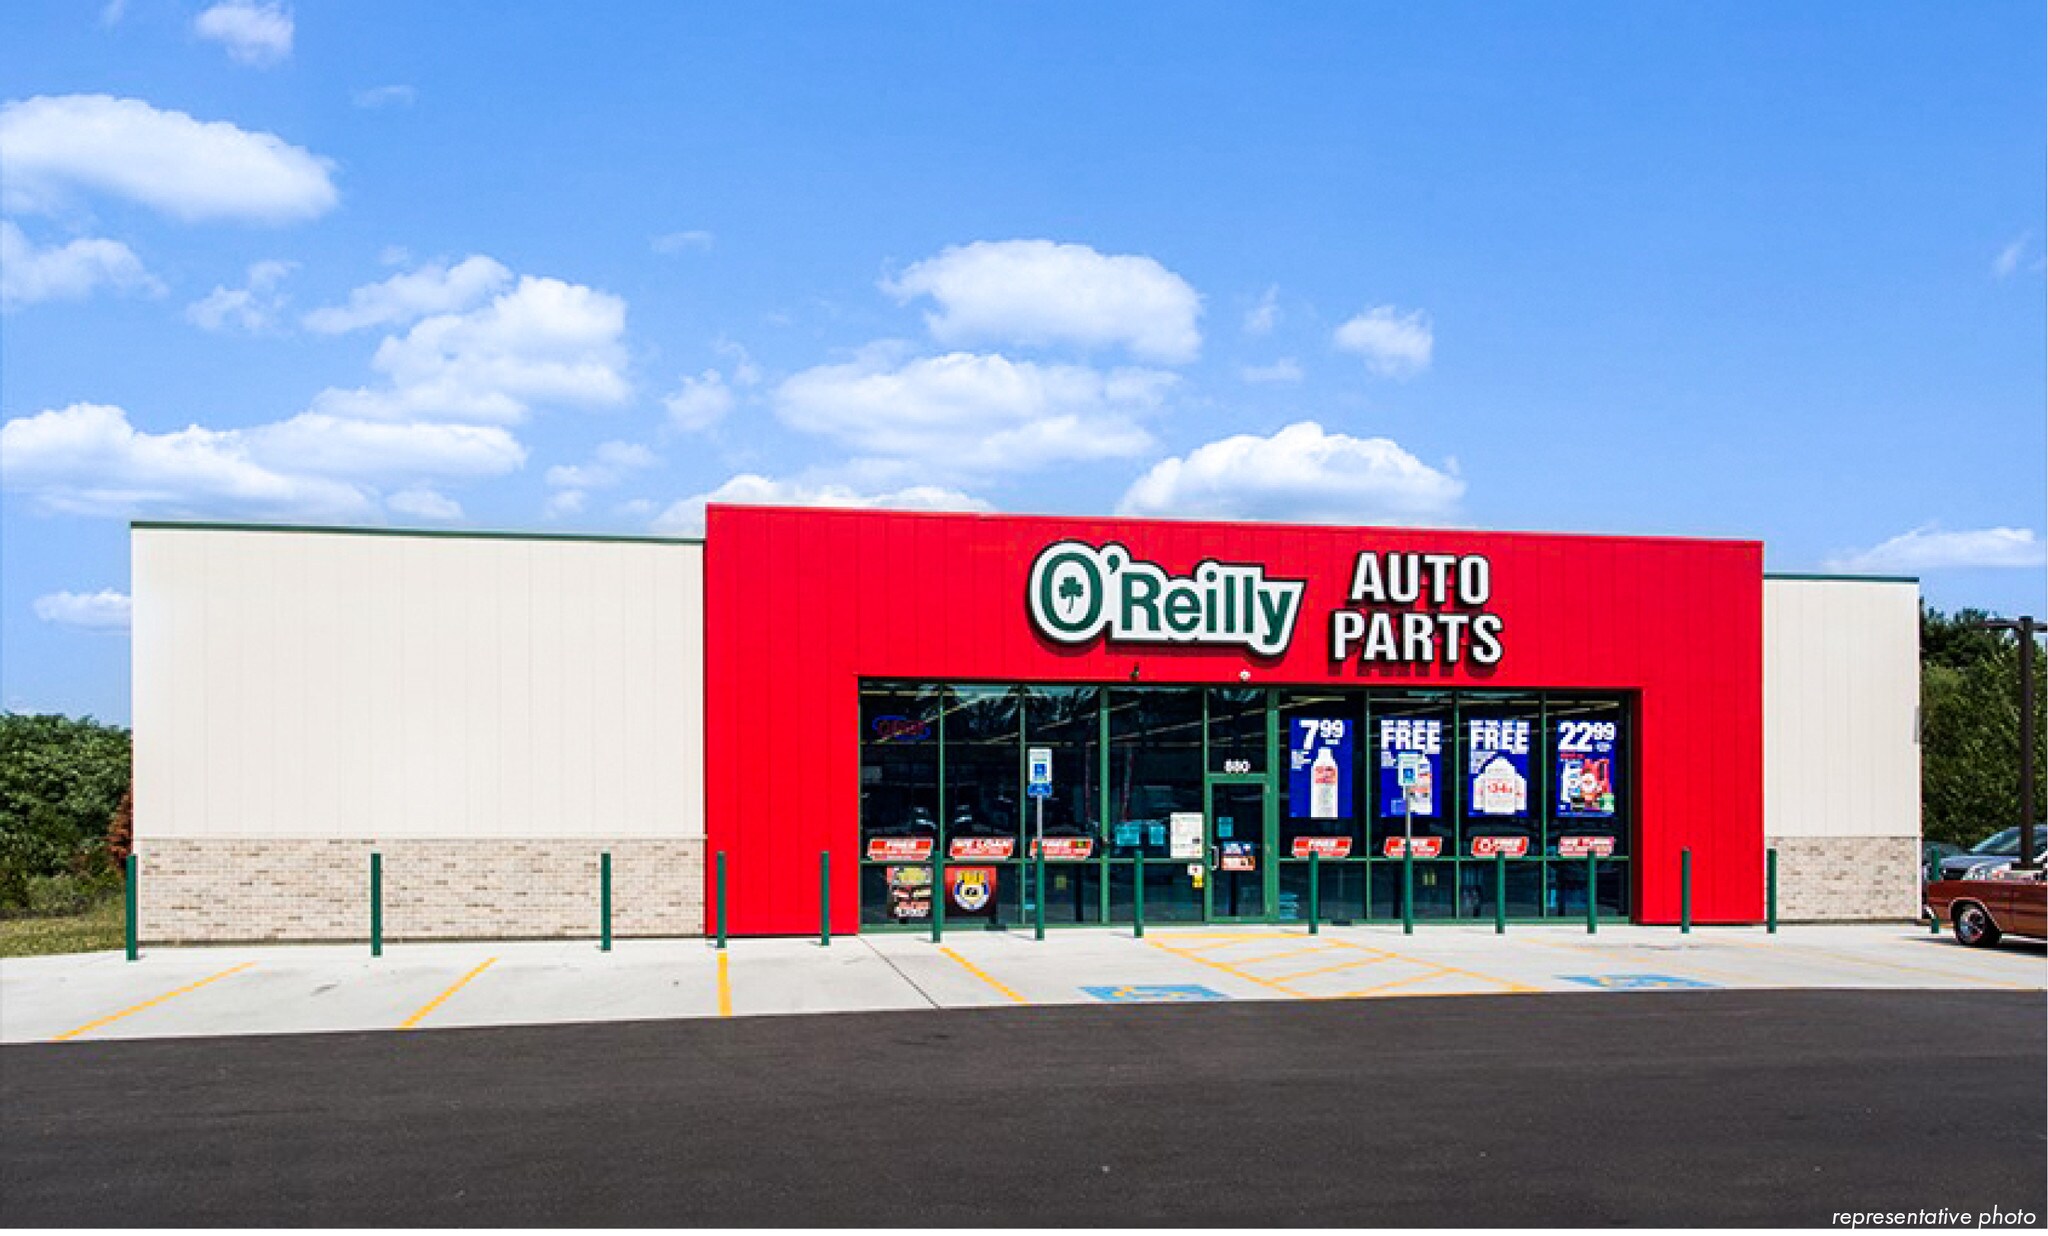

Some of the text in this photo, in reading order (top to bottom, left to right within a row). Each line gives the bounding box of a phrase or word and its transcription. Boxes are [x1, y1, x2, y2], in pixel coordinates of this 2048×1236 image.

[1037, 548, 1296, 647] O'Reilly
[1351, 551, 1489, 604] AUTO
[1333, 611, 1502, 663] PARTS
[1380, 729, 1441, 754] FREE
[1470, 729, 1528, 754] FREE
